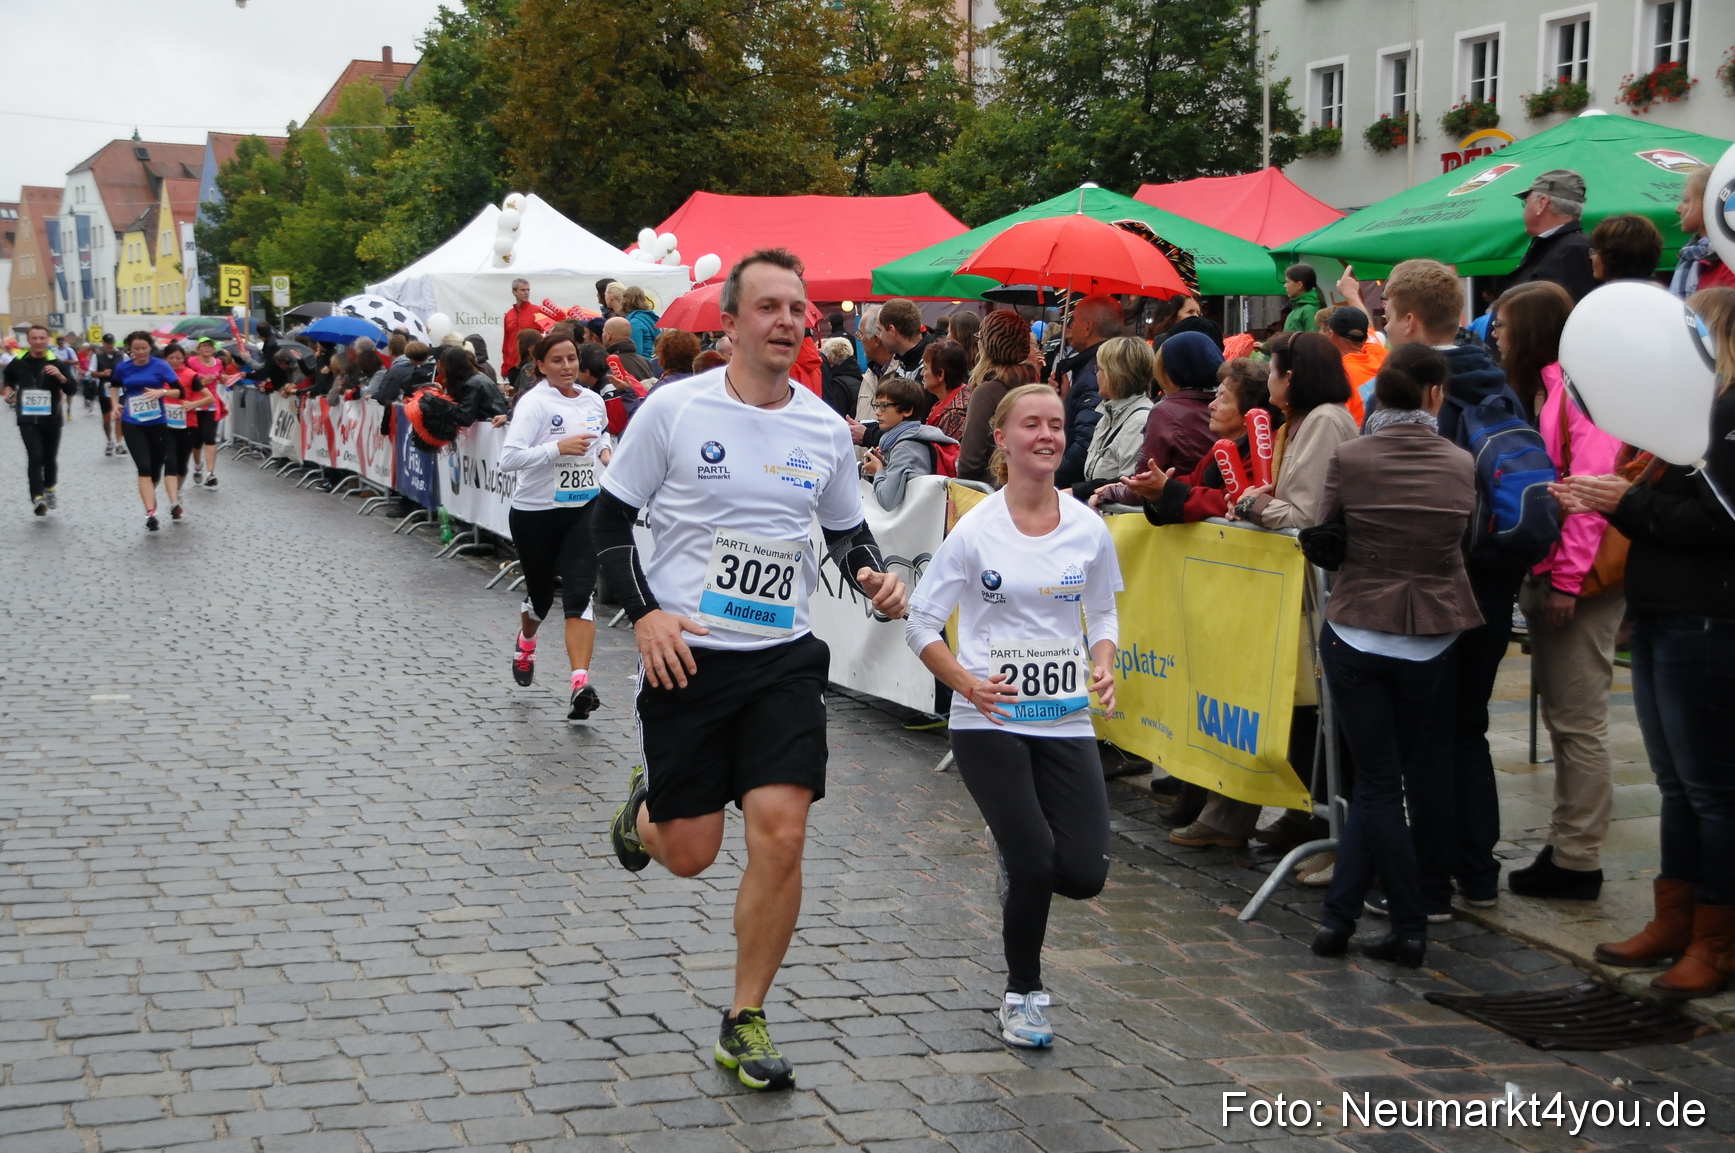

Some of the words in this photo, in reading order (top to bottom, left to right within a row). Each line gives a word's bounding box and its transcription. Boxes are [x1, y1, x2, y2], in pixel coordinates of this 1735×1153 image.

[225, 266, 246, 275] Block
[228, 278, 242, 297] B
[455, 311, 500, 325] Kinder
[560, 469, 594, 489] 2823
[698, 466, 730, 474] PARTL
[715, 536, 751, 553] PARTL
[752, 544, 794, 561] Neumarkt
[716, 554, 795, 600] 3028
[981, 590, 1006, 600] PARTL
[723, 601, 777, 623] Andreas
[990, 649, 1025, 658] PARTL
[1026, 647, 1070, 658] Neumarkt
[1000, 660, 1077, 696] 2860
[1014, 704, 1068, 719] Melanie
[1196, 690, 1260, 756] KANN
